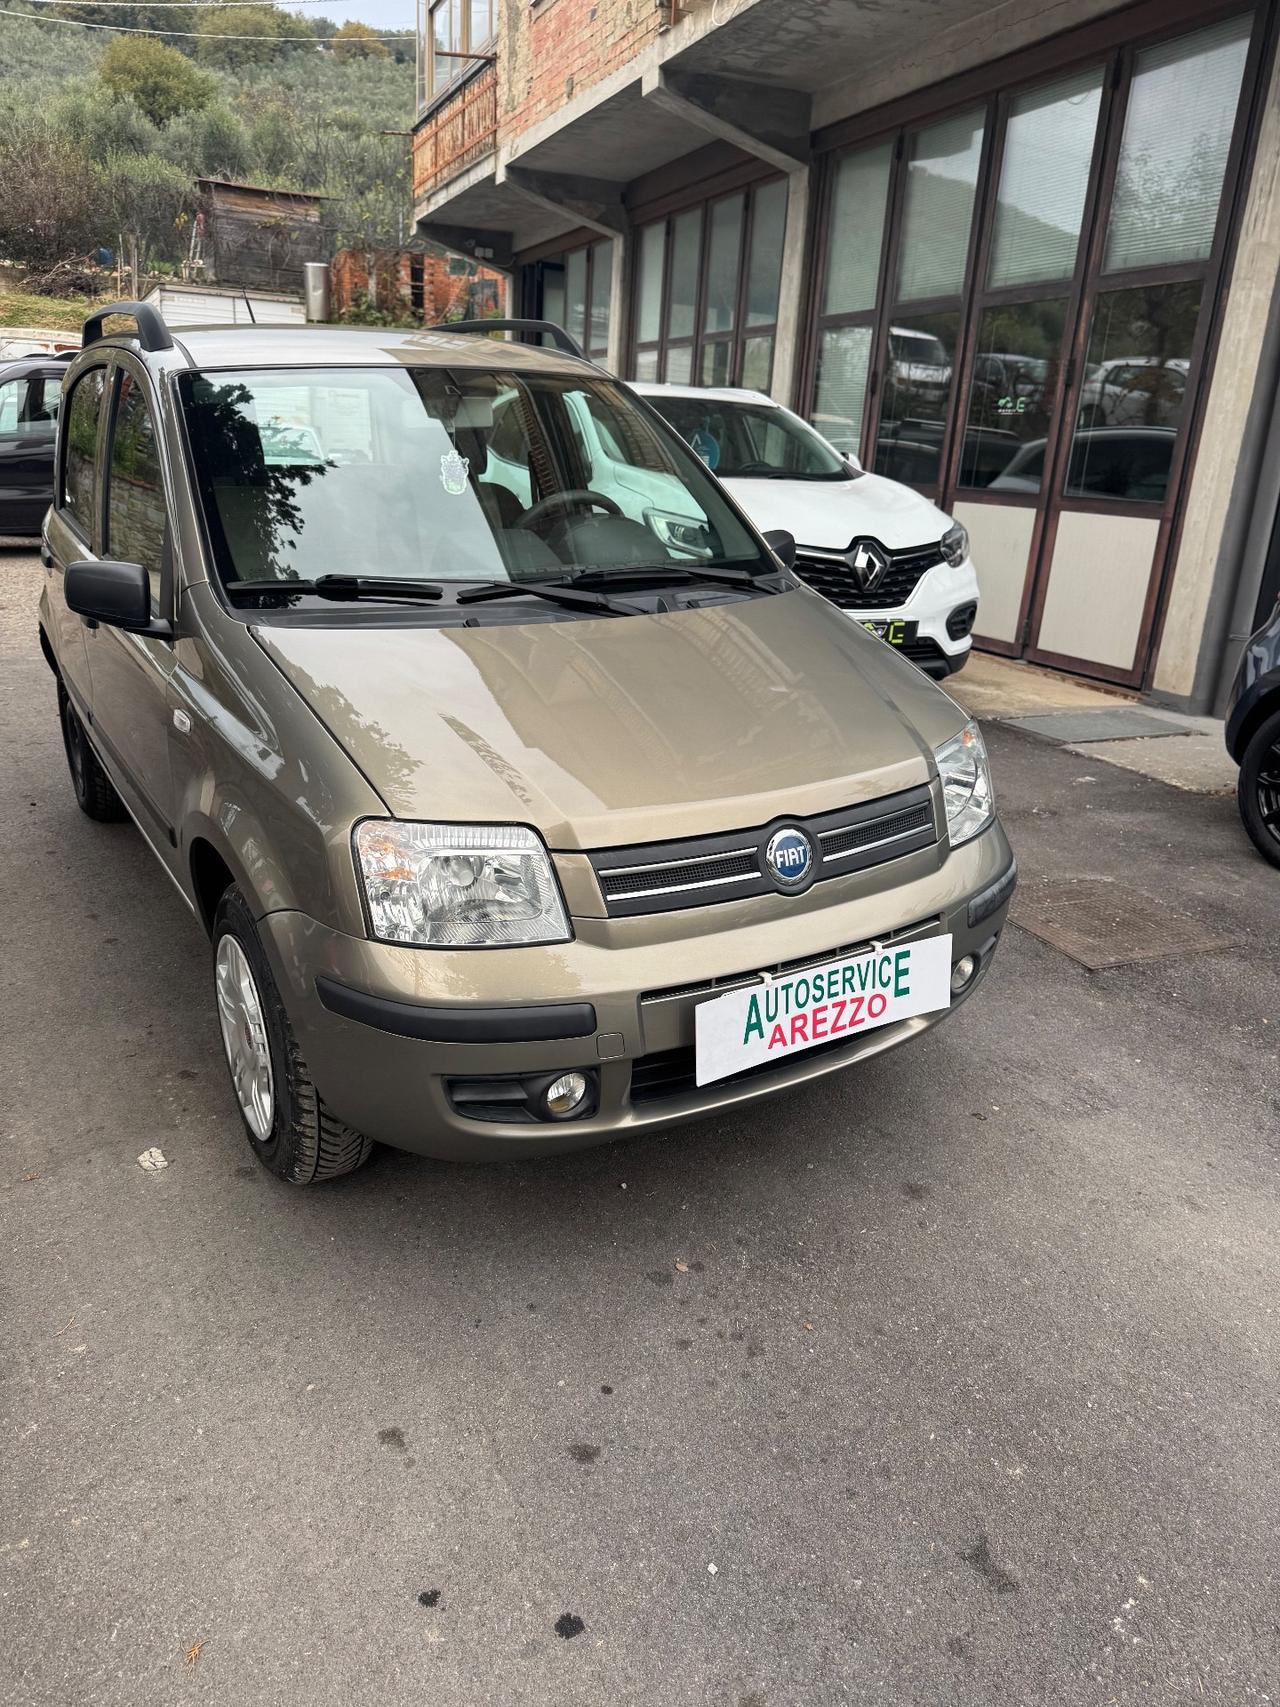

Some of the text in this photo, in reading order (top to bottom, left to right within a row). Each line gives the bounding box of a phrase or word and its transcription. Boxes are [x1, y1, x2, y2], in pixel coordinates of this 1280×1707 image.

[776, 846, 805, 868] FIAT
[743, 950, 911, 1044] AUTOSERVICE
[768, 993, 887, 1049] AREZZO
